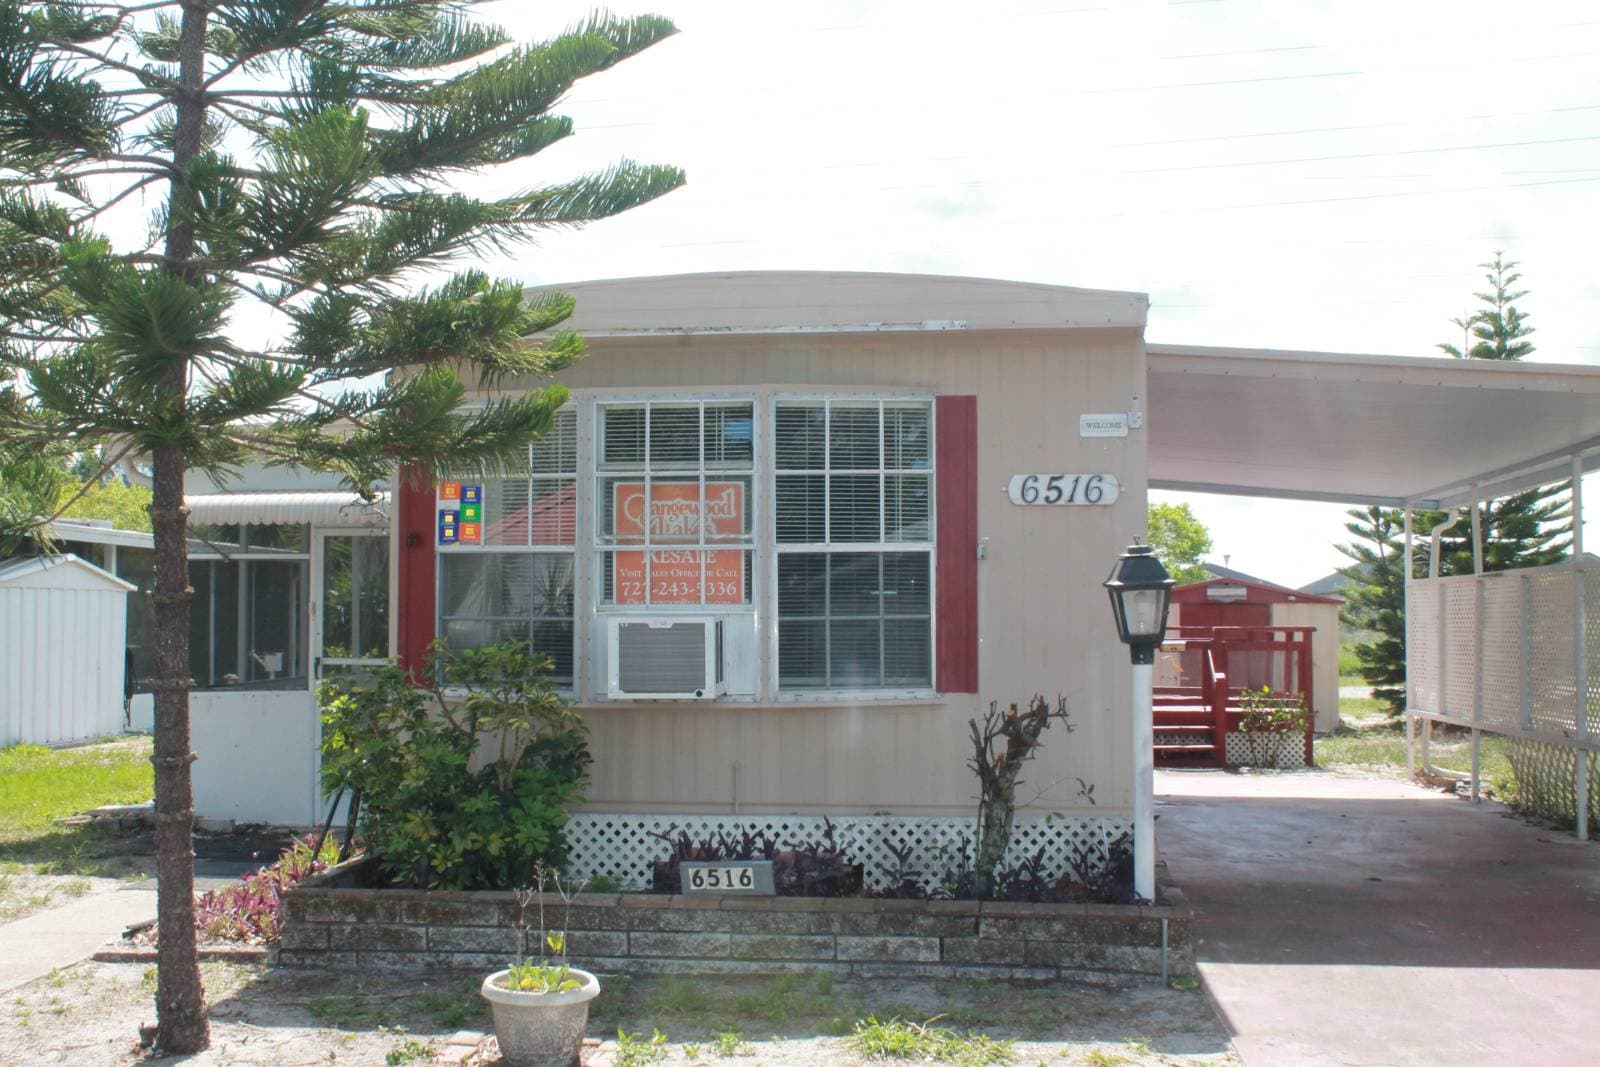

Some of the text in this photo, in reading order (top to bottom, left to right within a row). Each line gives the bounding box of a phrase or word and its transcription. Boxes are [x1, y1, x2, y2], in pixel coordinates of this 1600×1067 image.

[1085, 421, 1122, 430] WELCOME
[1021, 474, 1105, 504] 6516
[624, 488, 736, 521] Oangewood
[645, 568, 669, 577] ALES
[621, 581, 737, 597] 72-243-336
[691, 868, 752, 888] 6516
